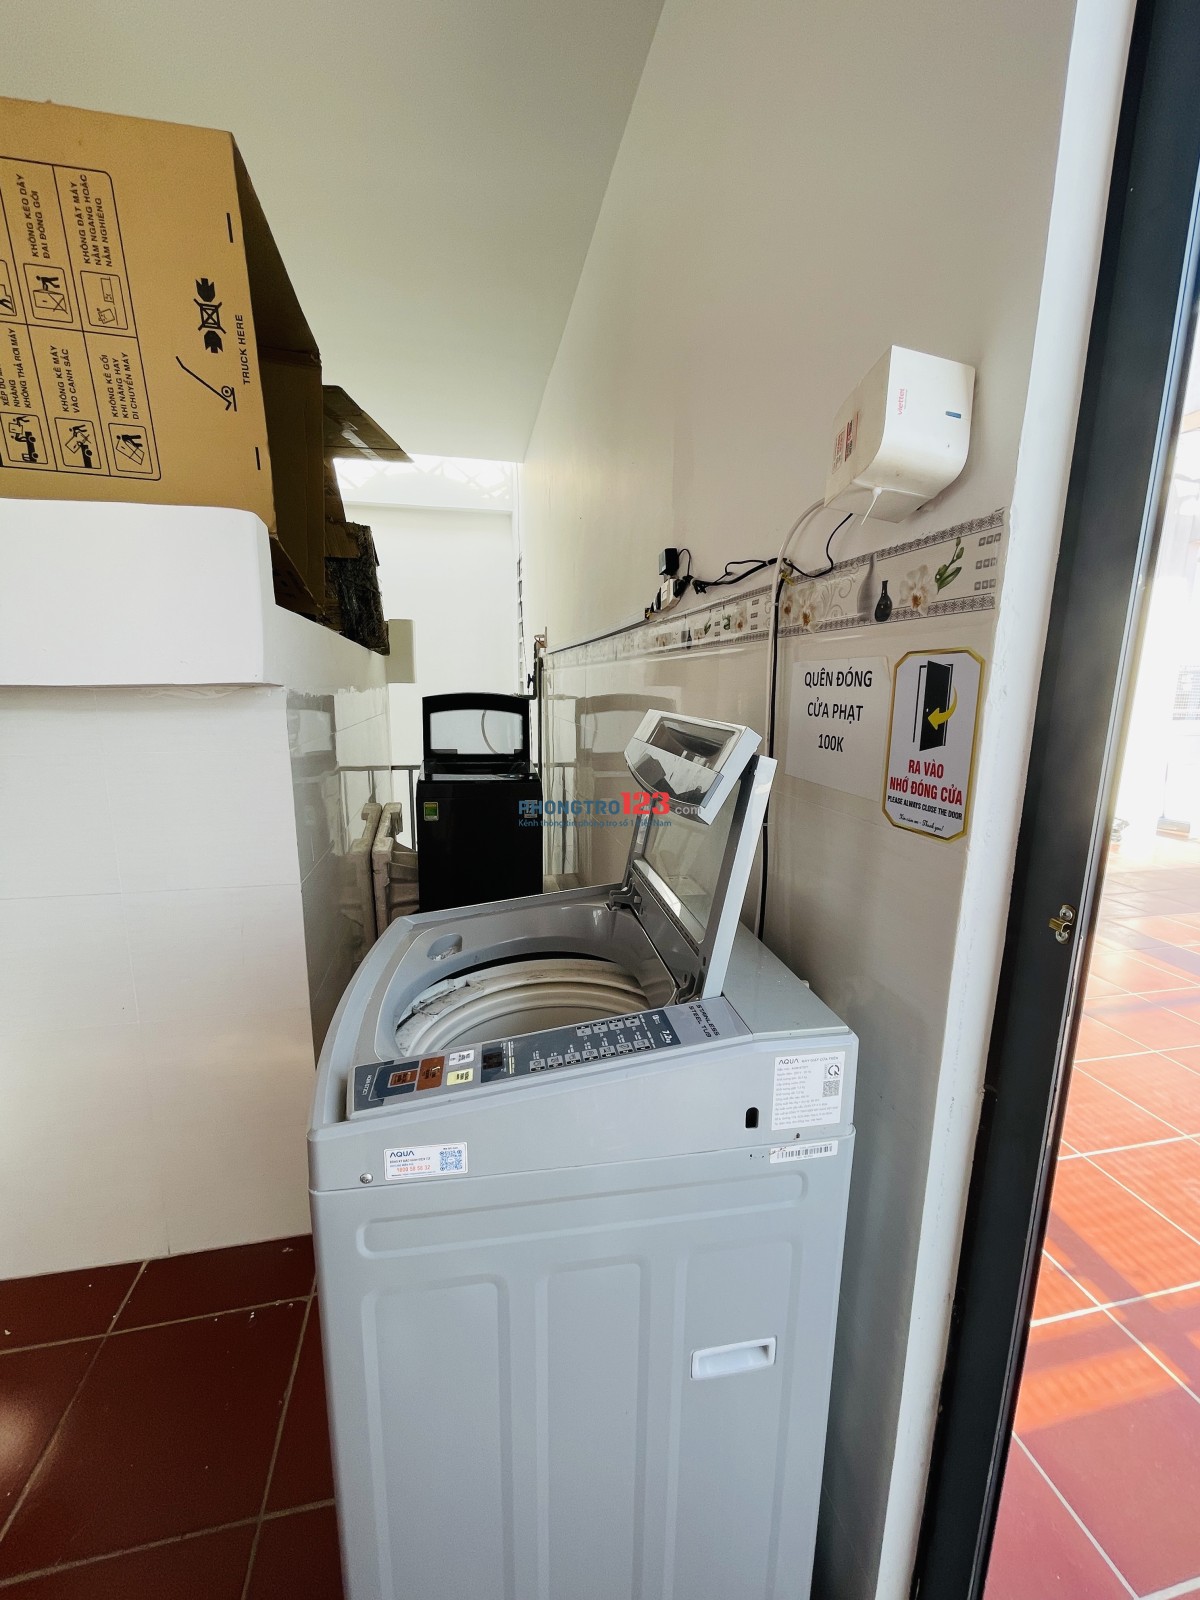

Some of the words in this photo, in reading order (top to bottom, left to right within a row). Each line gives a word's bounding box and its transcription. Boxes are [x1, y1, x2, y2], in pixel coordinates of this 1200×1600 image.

[70, 181, 81, 204] MÁY
[86, 206, 98, 242] NGANG
[26, 222, 39, 258] KHÔNG
[79, 230, 91, 264] KHÔNG
[8, 328, 19, 346] MÁY
[235, 314, 246, 345] HERE
[50, 345, 61, 364] MÁY
[121, 352, 131, 372] MÁY
[112, 358, 121, 375] HAY
[239, 348, 250, 385] TRUCK
[20, 380, 32, 408] KHÔNG
[58, 382, 70, 413] KHÔNG
[108, 387, 119, 418] KHÔNG
[120, 403, 129, 419] KHI
[133, 411, 139, 420] DI
[804, 667, 833, 688] QUÊN
[836, 666, 873, 688] ĐÓNG
[807, 696, 829, 718] CỬA
[832, 703, 864, 724] PHẠT
[818, 733, 844, 753] 100K
[908, 759, 921, 775] RA
[924, 759, 945, 779] VÀO
[889, 776, 909, 793] NHỚ
[911, 779, 938, 800] ĐÓNG
[940, 784, 963, 806] CỬA
[887, 795, 903, 805] PLEASE
[903, 799, 921, 810] ALWAYS
[922, 804, 937, 814] CLOSE
[938, 807, 947, 817] THE
[948, 811, 963, 821] DOOR
[689, 1005, 701, 1025] STEEL
[390, 1150, 415, 1158] AQUA
